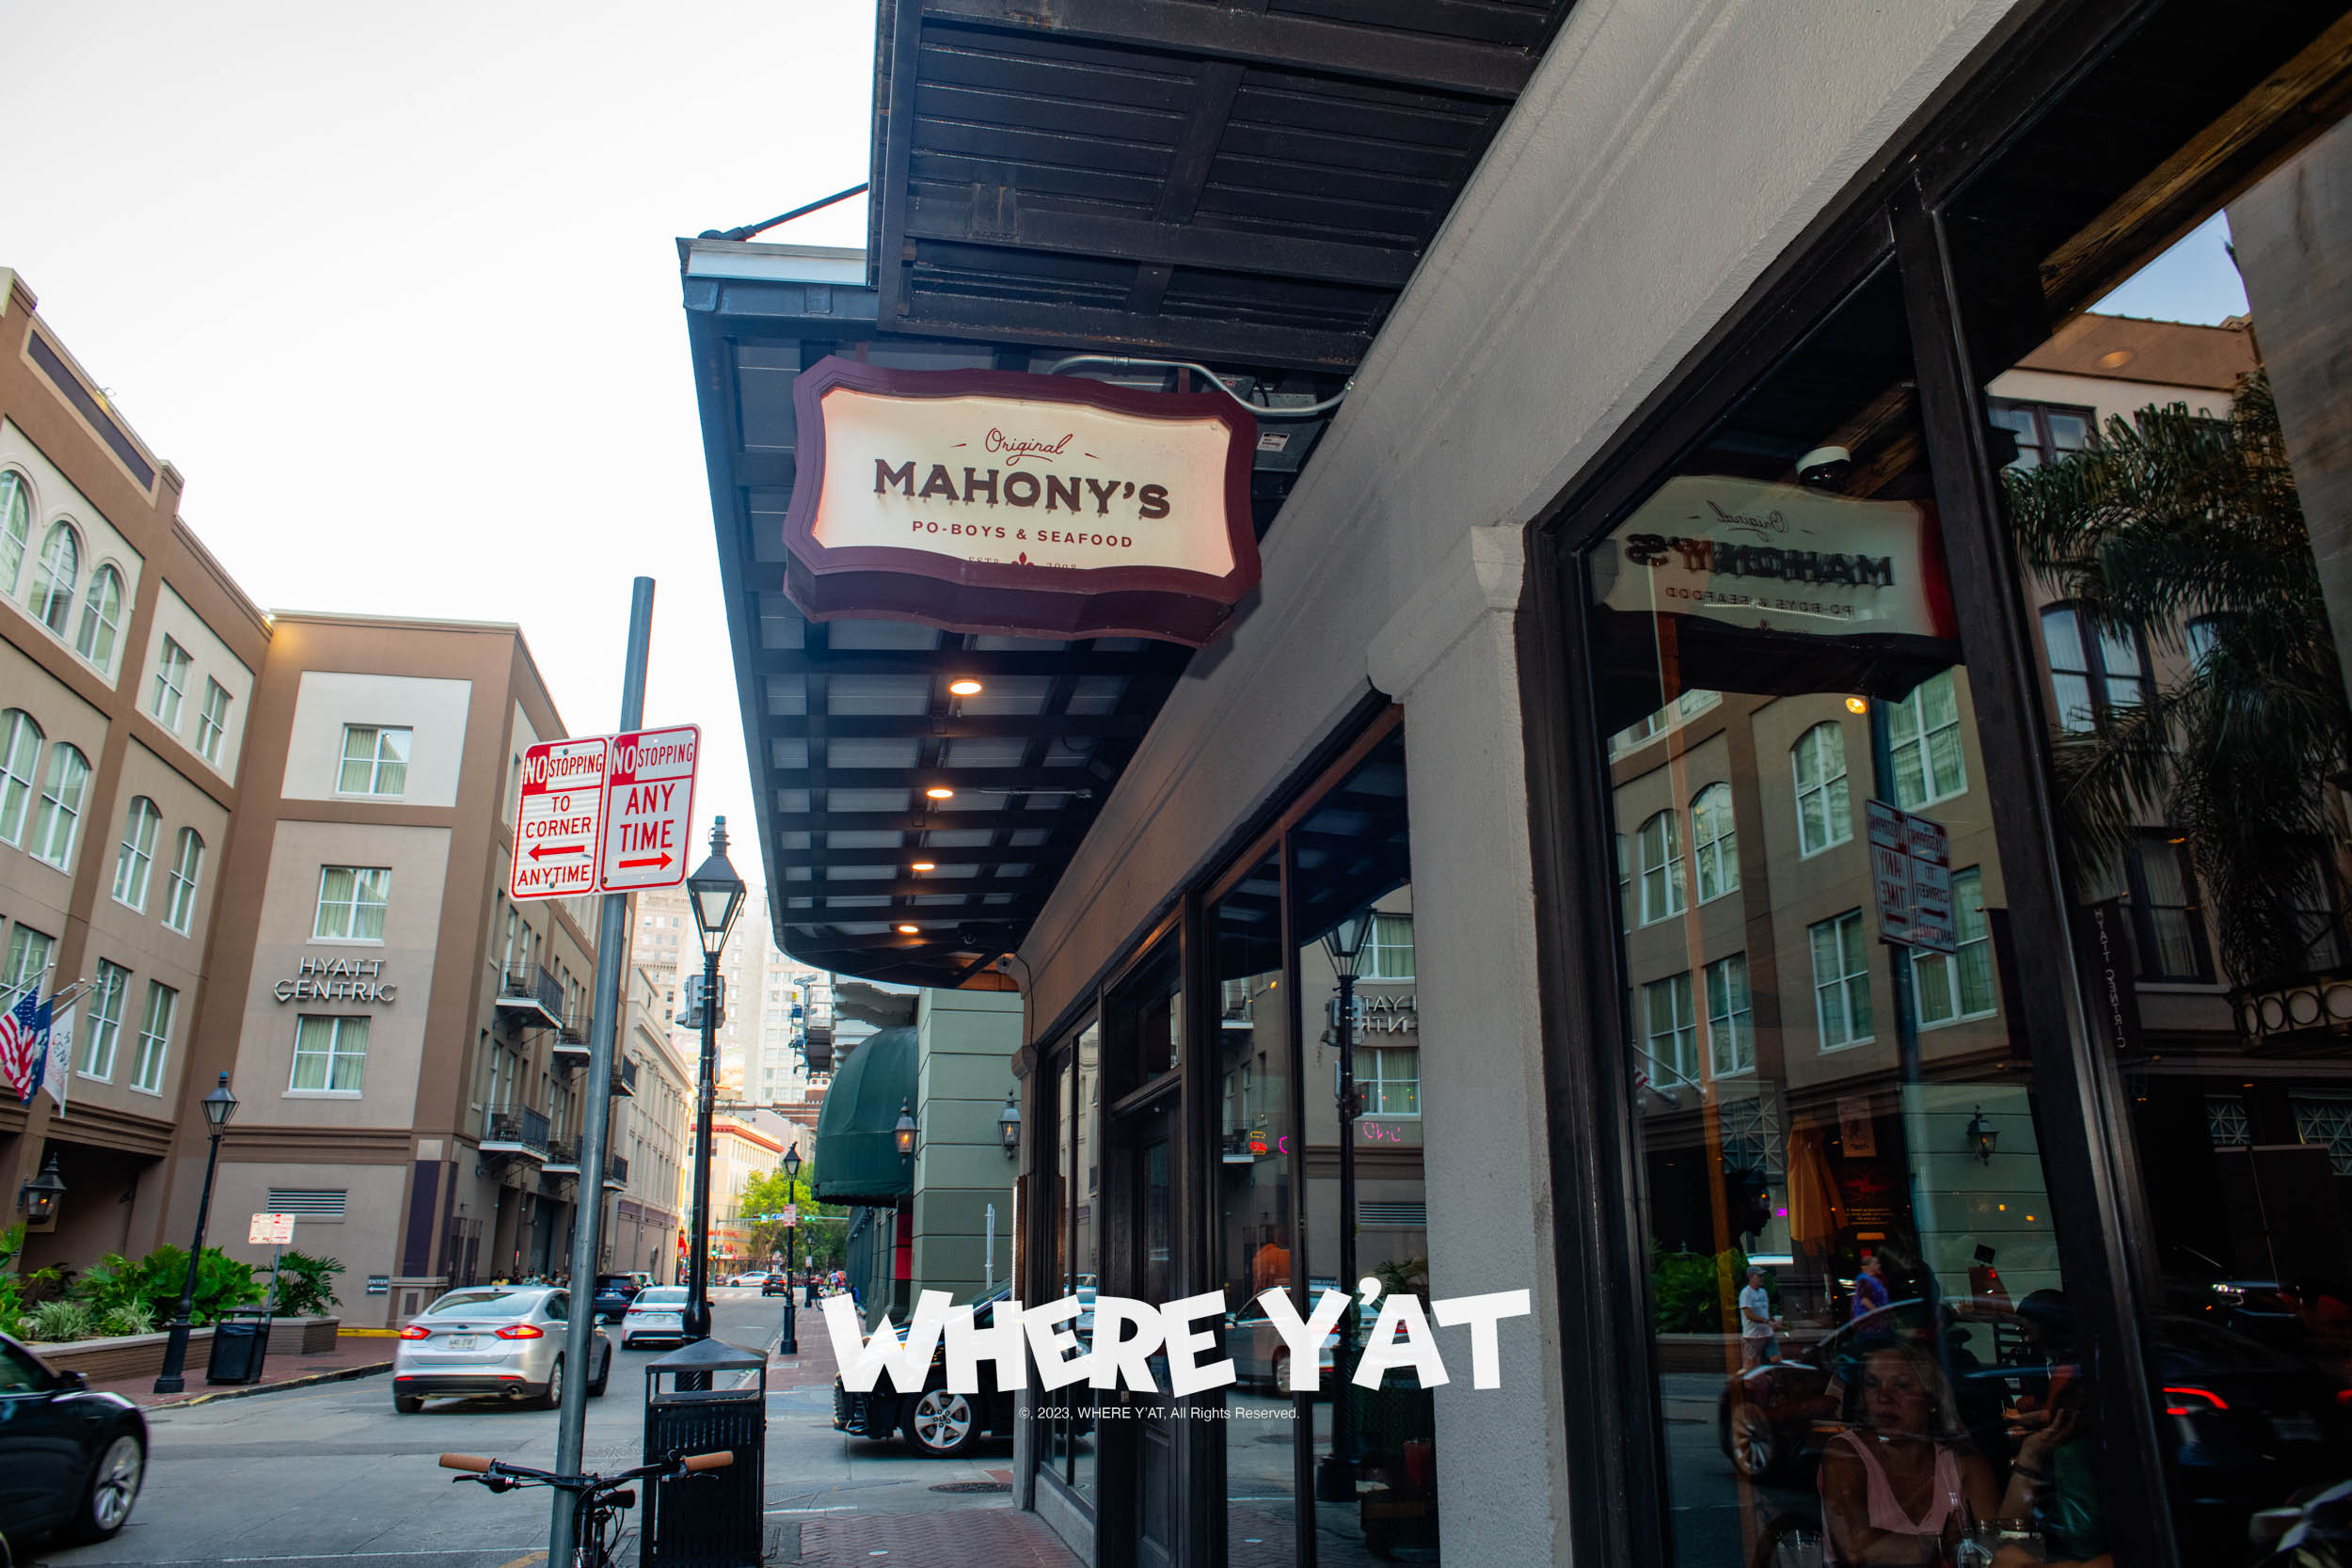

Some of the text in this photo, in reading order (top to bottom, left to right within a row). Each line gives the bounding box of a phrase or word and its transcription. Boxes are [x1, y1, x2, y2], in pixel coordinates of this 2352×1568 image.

[984, 427, 1073, 466] Original
[873, 458, 1171, 520] MAHONY'S
[912, 519, 1134, 548] PO-BOYS & SEAFOOD
[523, 753, 603, 785] NO STOPPING
[612, 742, 694, 776] NO STOPPING
[551, 795, 571, 813] TO
[625, 783, 676, 816] ANY
[525, 816, 592, 838] CORNER
[619, 819, 675, 852] TIME
[516, 864, 591, 887] ANYTIME
[298, 956, 386, 978] HYATT
[274, 978, 397, 1002] CENTRIC
